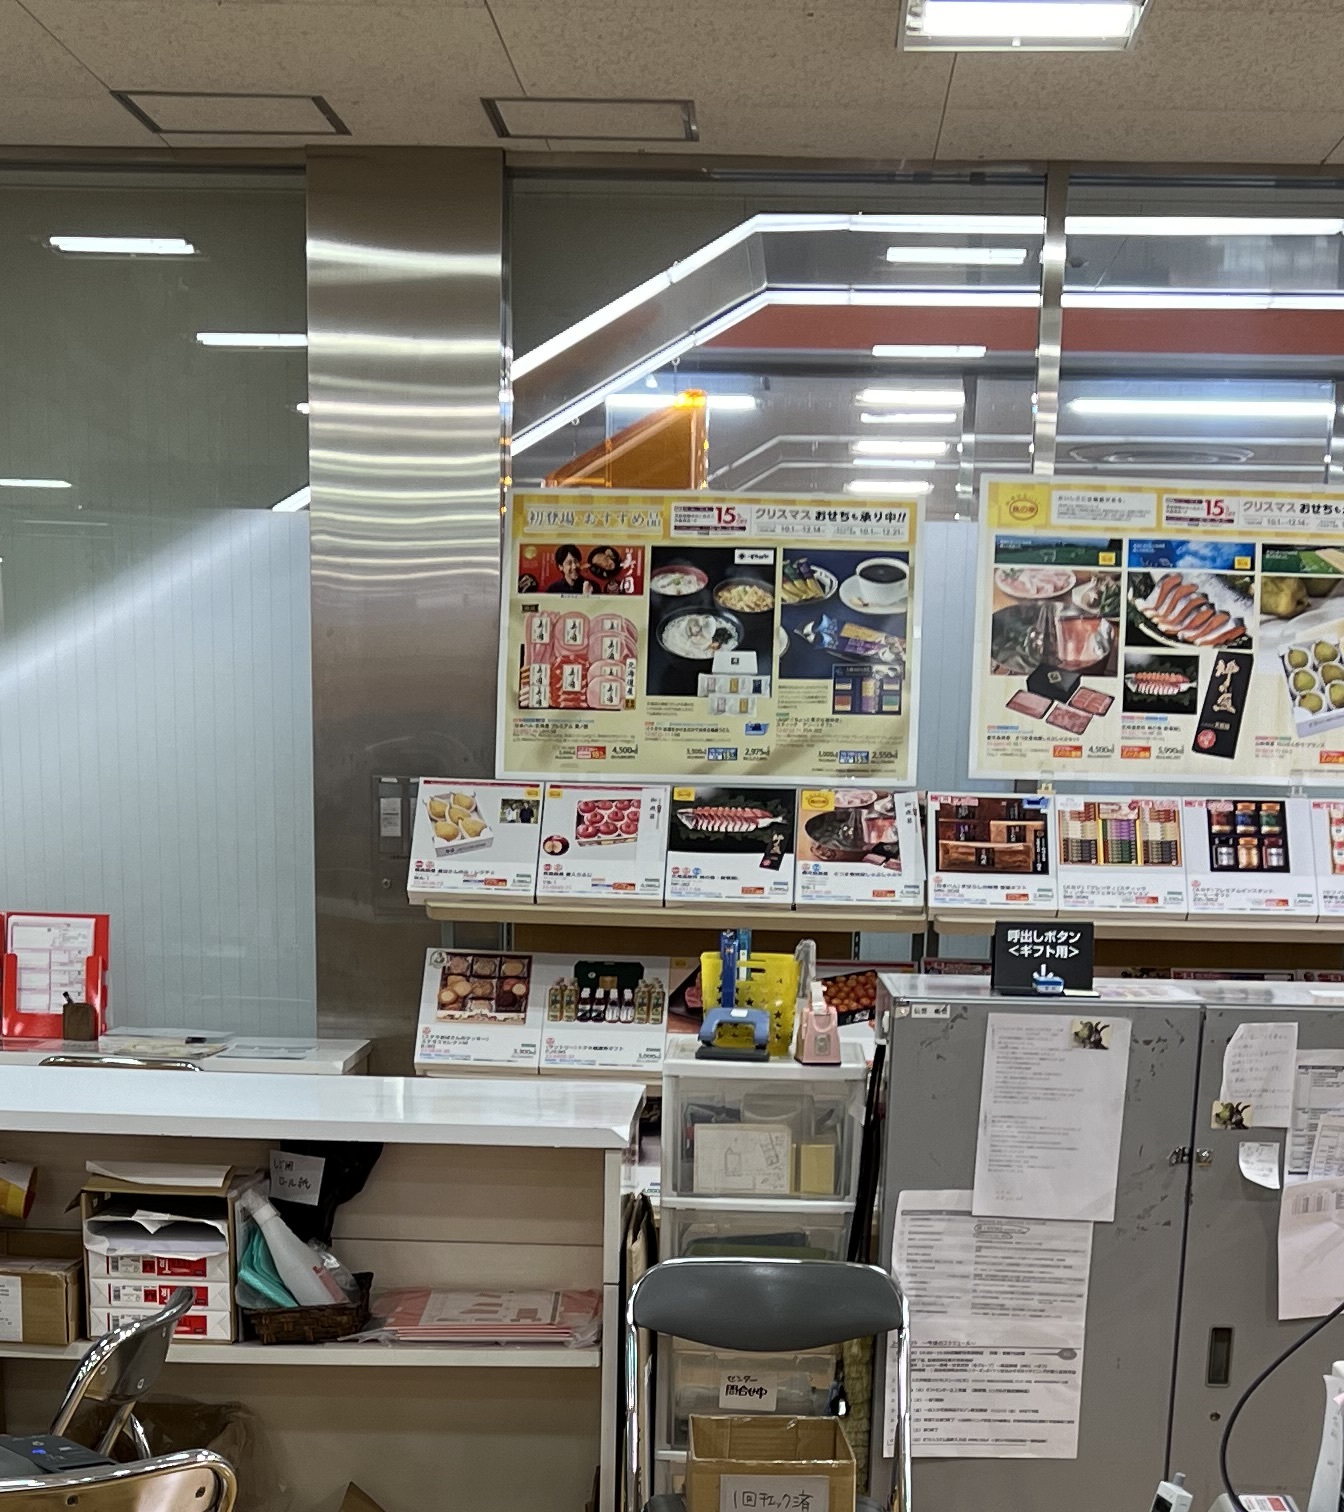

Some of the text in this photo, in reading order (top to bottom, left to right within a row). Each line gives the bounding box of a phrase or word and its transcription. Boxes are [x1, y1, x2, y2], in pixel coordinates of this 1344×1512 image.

[756, 508, 811, 521] クリスマス
[1205, 500, 1225, 517] 15
[1243, 501, 1297, 514] クリスマス
[715, 506, 736, 525] 15
[1007, 929, 1081, 944] 呼出しボタン
